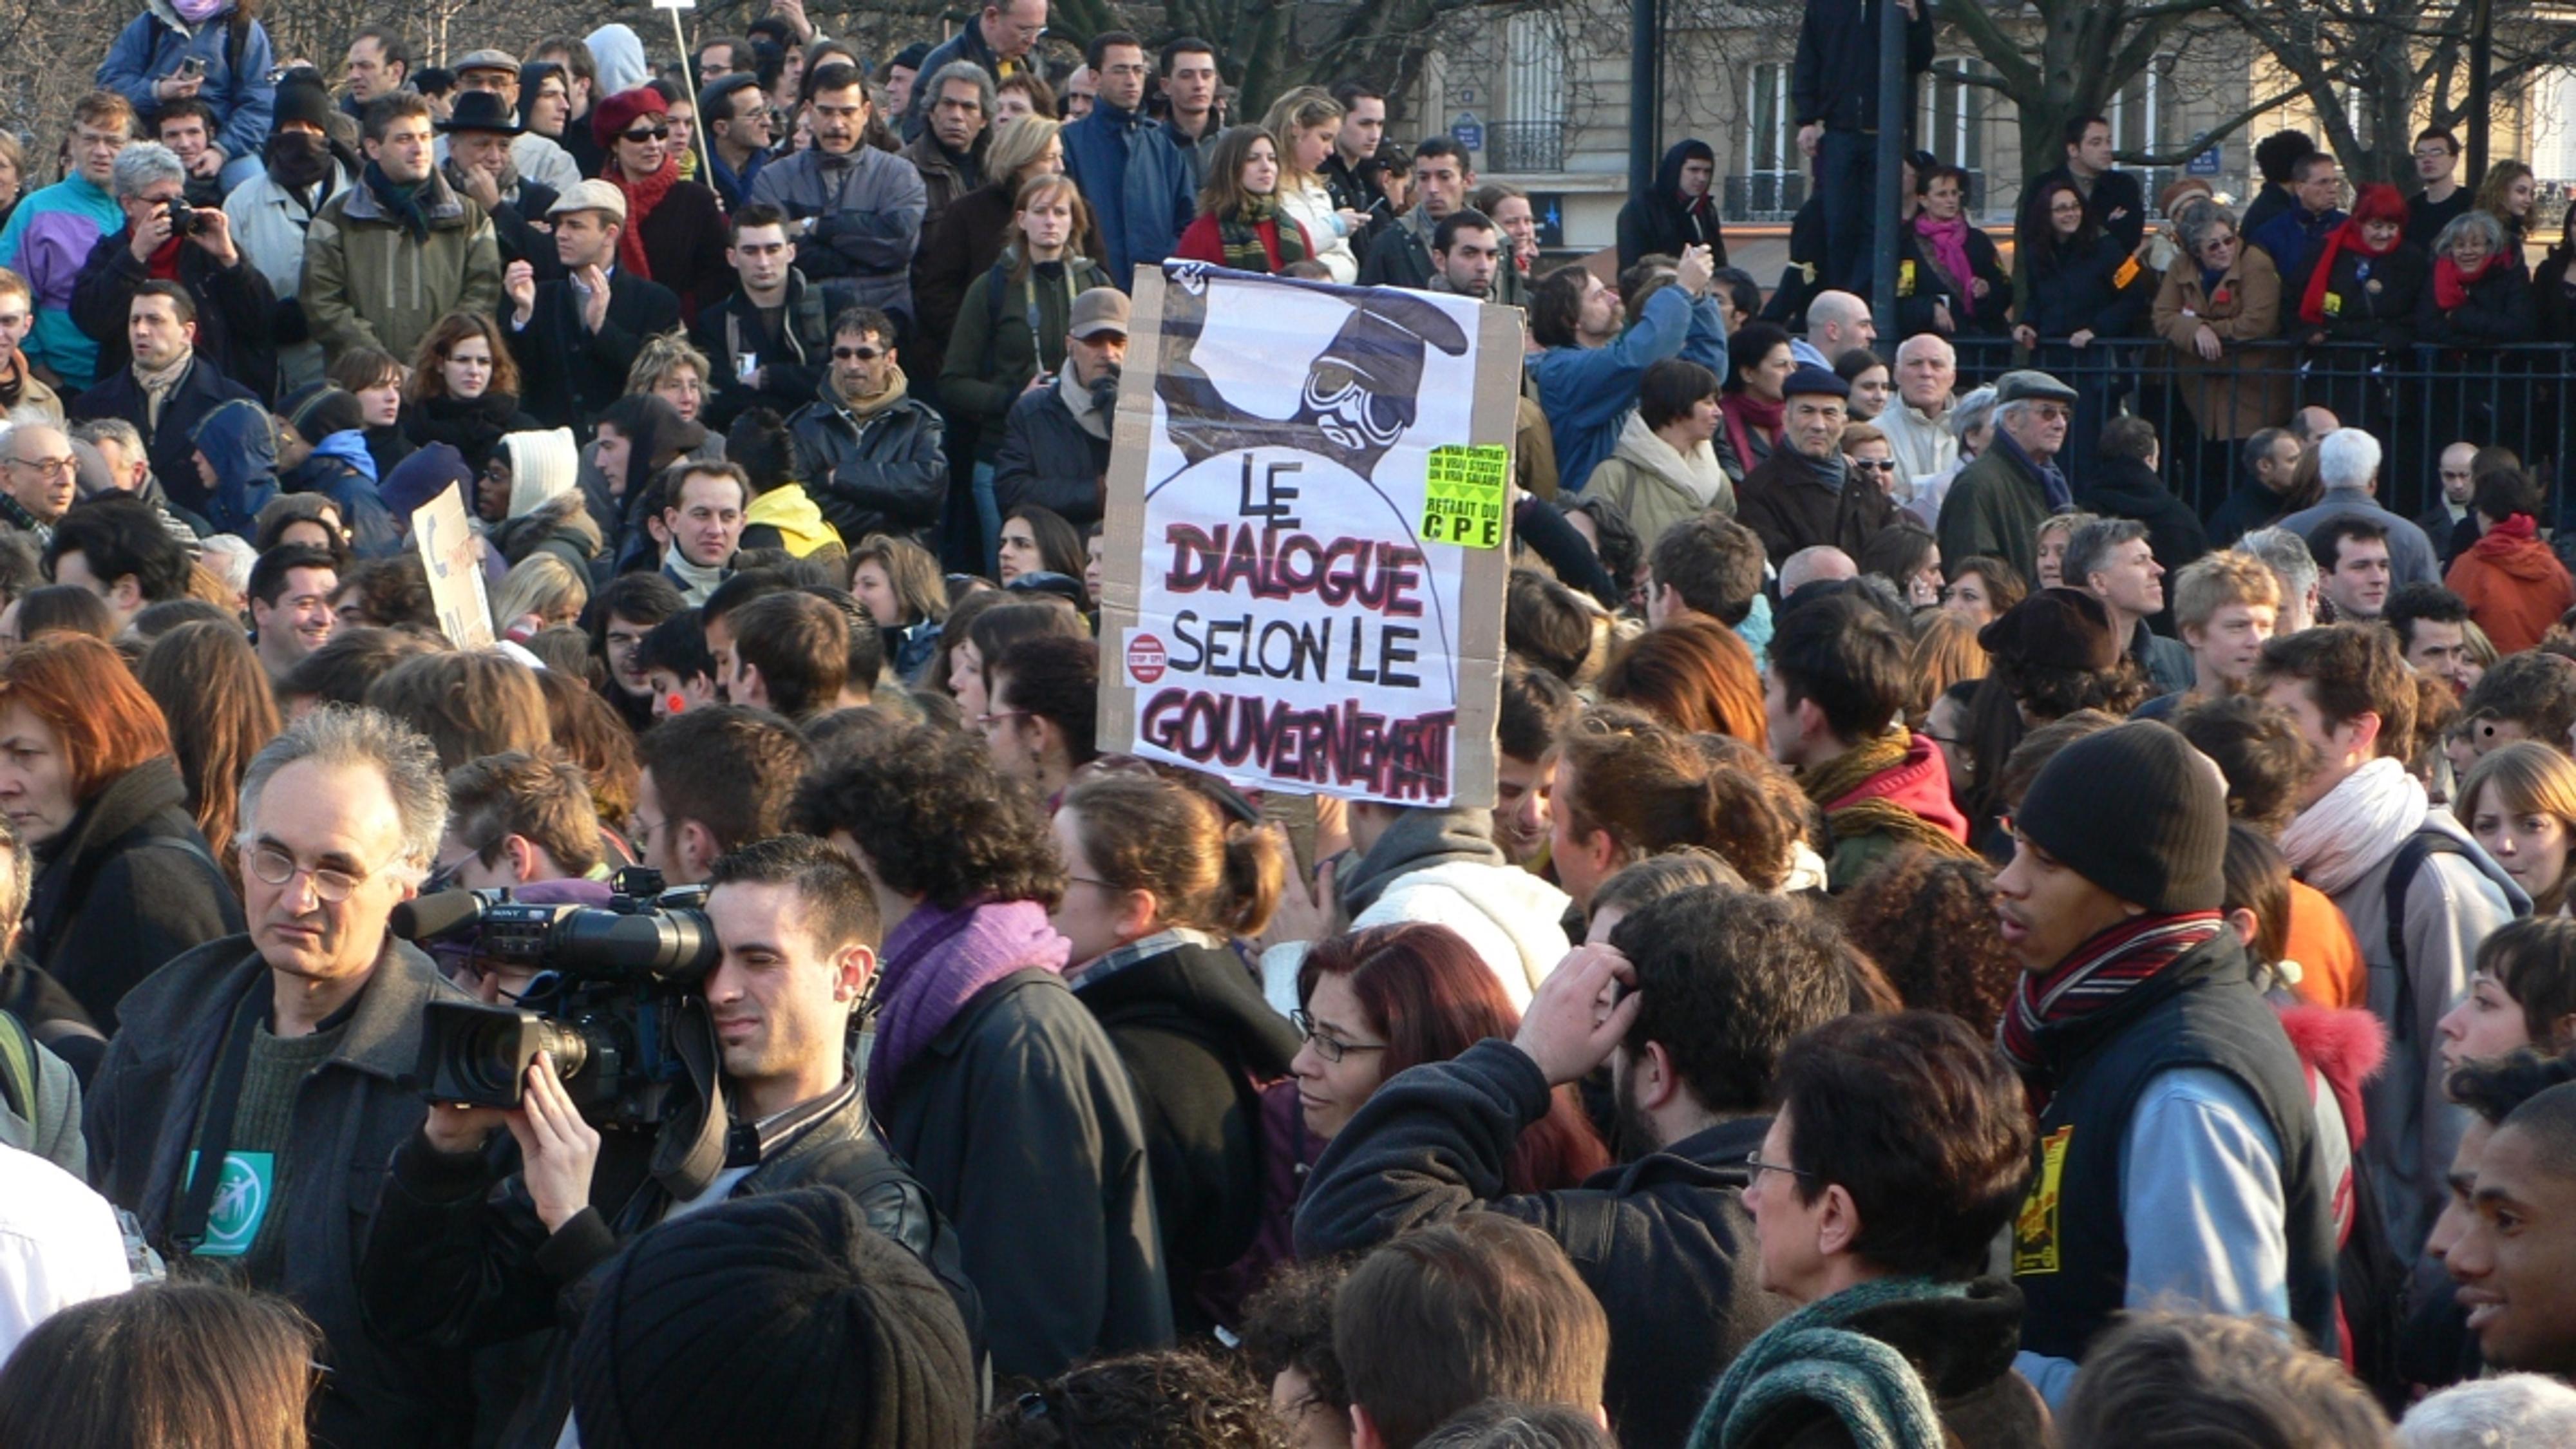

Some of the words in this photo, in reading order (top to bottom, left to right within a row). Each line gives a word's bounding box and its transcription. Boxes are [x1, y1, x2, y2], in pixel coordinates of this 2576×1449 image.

[1239, 453, 1302, 529] LE
[1426, 498, 1477, 516] RETRAIT
[1482, 503, 1499, 520] DU
[1166, 522, 1423, 617] DIALOGUE
[1168, 610, 1331, 683] SELON
[1347, 616, 1420, 688] LE
[1142, 687, 1455, 804] GOUVERNEMENT
